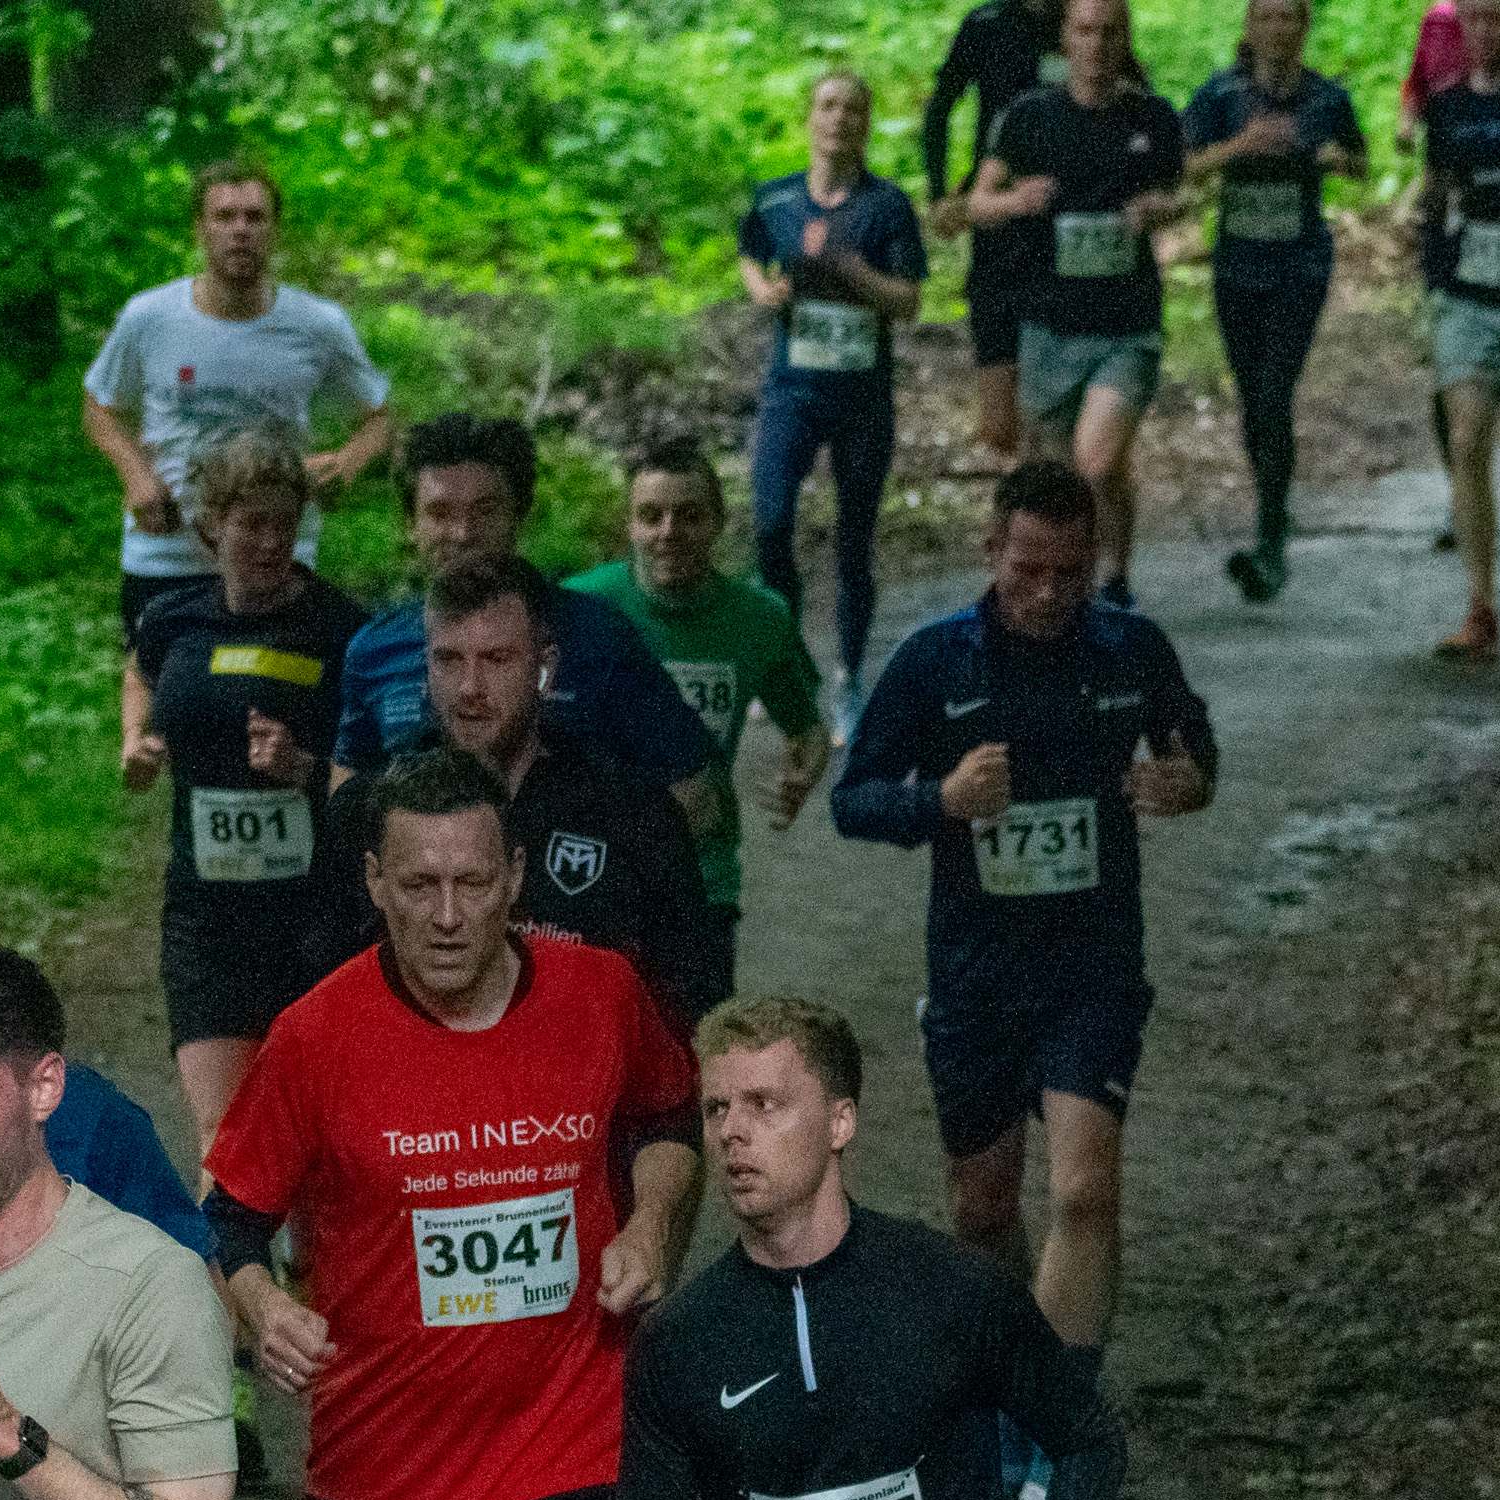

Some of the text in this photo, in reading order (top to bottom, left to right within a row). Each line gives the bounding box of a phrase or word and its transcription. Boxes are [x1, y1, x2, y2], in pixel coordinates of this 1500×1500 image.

[210, 808, 288, 844] 801
[979, 817, 1089, 857] 1731
[382, 1129, 461, 1157] Team
[401, 1174, 448, 1194] Jede
[454, 1165, 538, 1190] Sekunde
[424, 1199, 567, 1230] Everstener Brunnenlauf
[422, 1214, 572, 1278] 3047
[484, 1275, 525, 1288] Stefan
[523, 1280, 572, 1306] bruns
[438, 1291, 498, 1317] EWE
